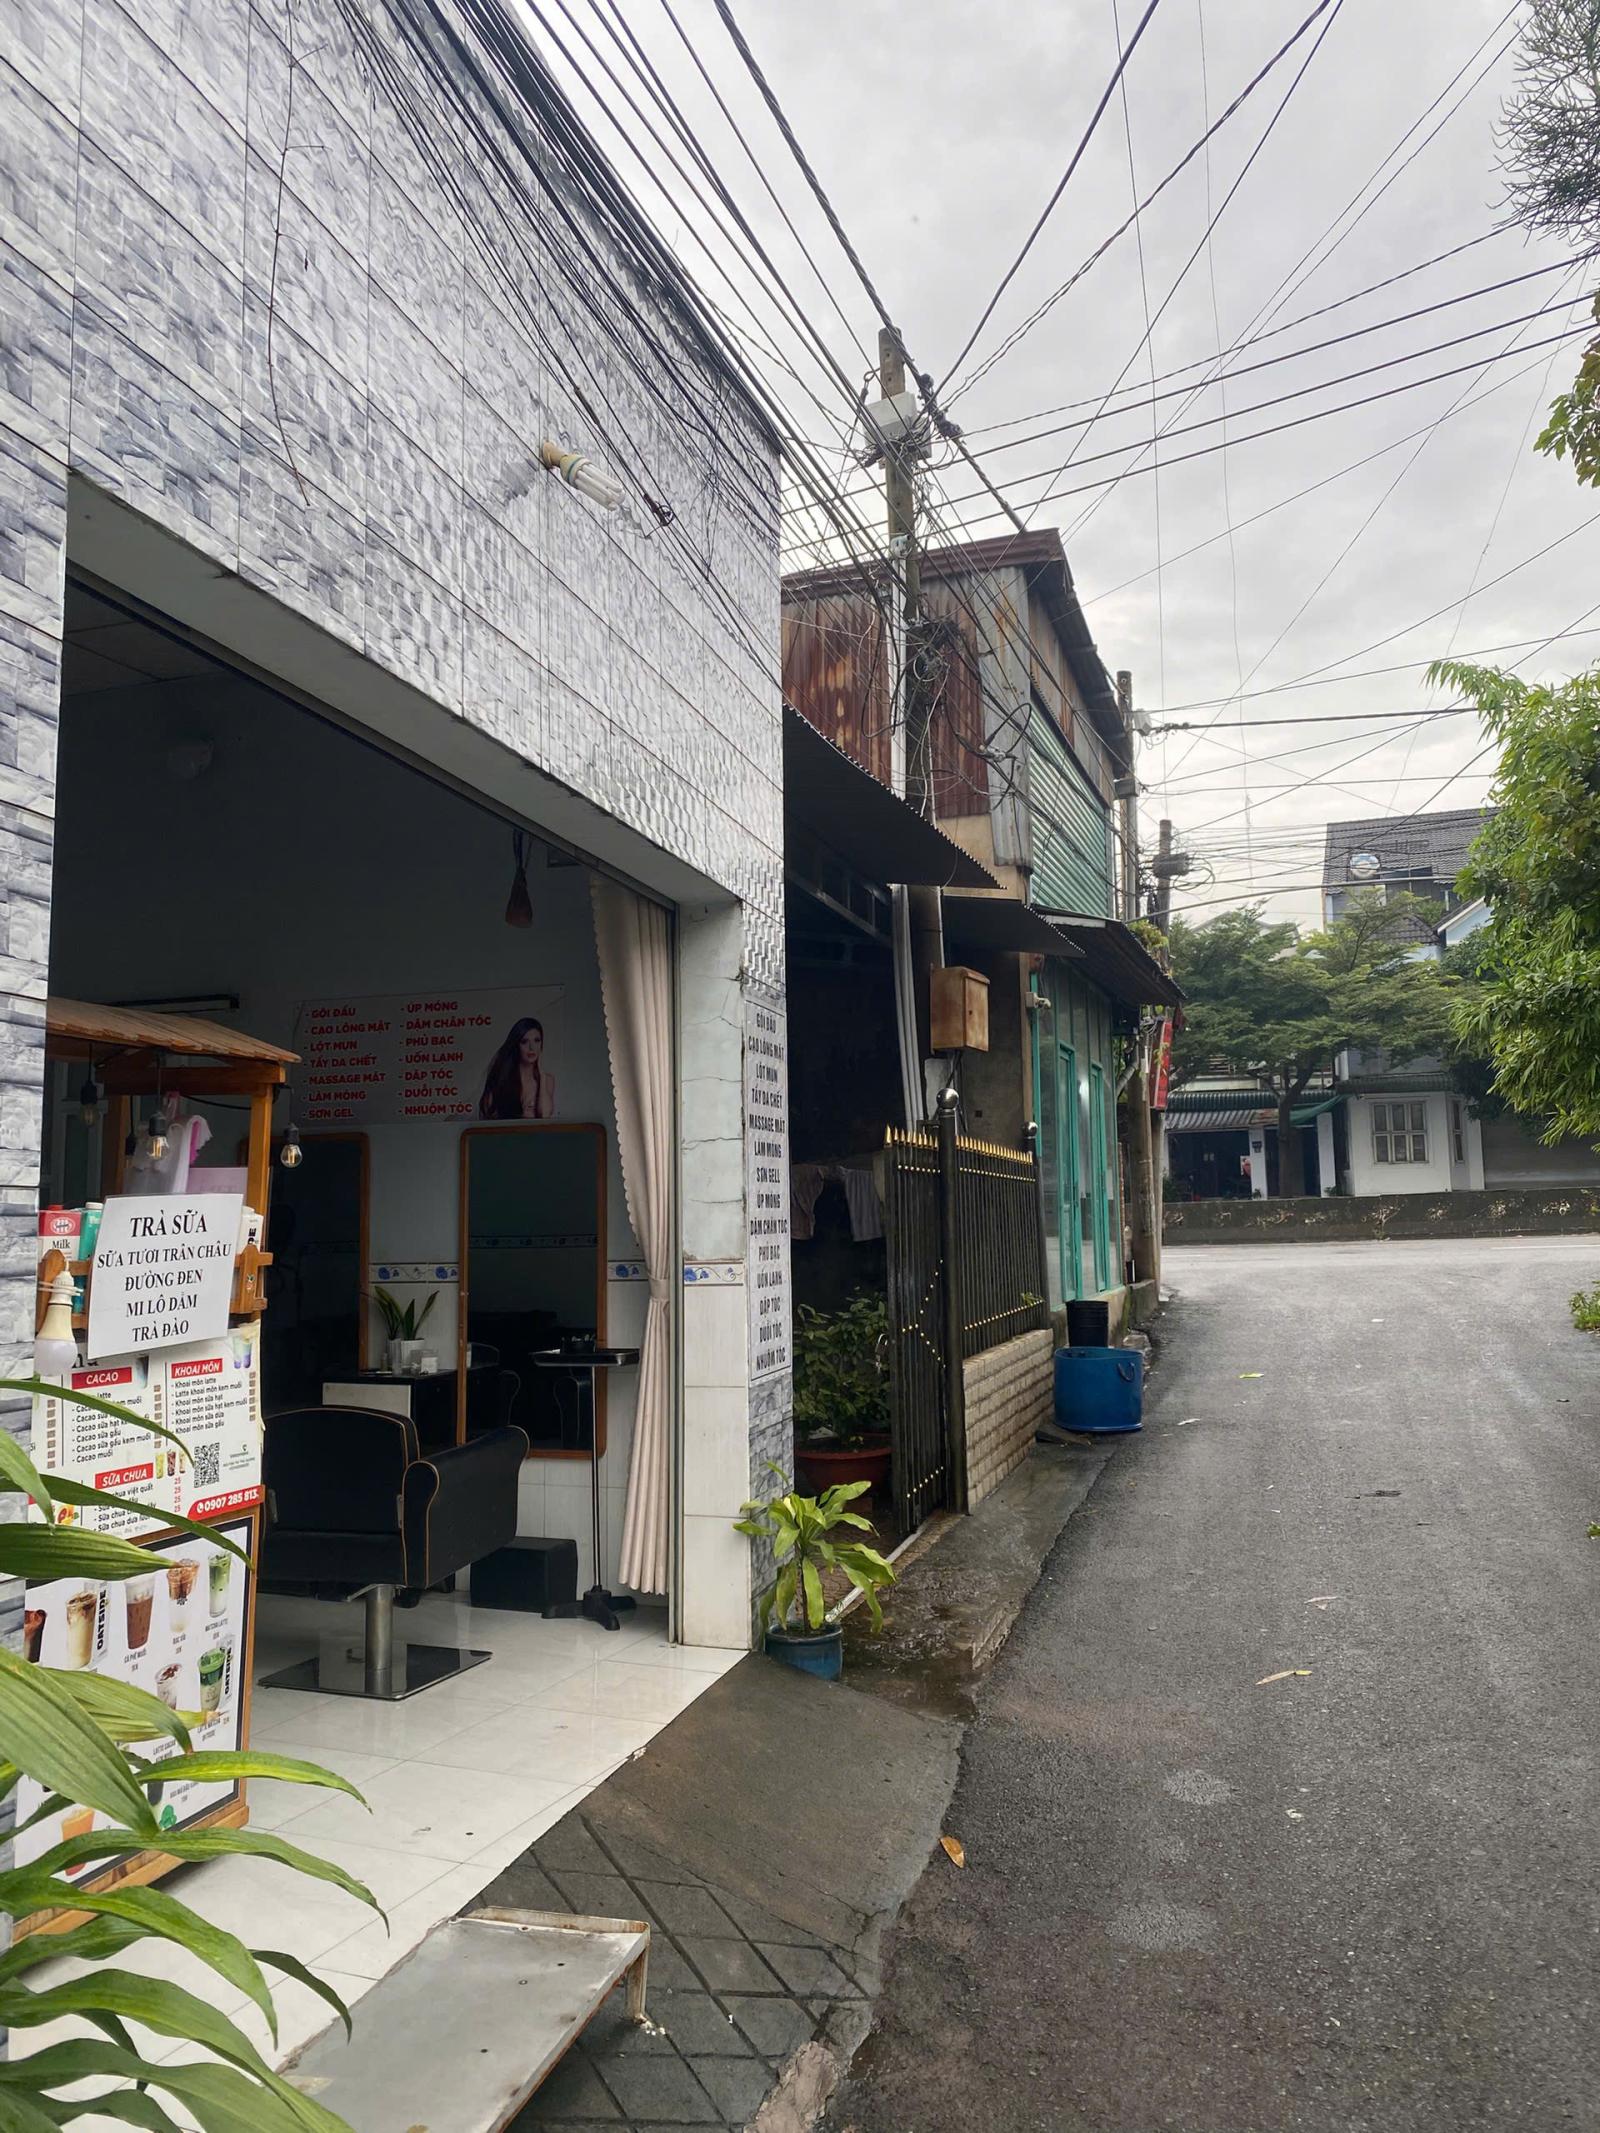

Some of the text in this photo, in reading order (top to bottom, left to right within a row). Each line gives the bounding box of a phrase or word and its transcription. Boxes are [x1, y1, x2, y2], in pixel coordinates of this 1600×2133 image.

[424, 1000, 458, 1012] MÓNG
[433, 1016, 465, 1028] CHÂN
[468, 1014, 492, 1026] TÓC
[336, 1022, 365, 1033] LÔNG
[431, 1036, 454, 1048] BẠC
[332, 1058, 346, 1067] DA
[349, 1052, 377, 1066] CHẾT
[432, 1051, 463, 1065] LẠNH
[309, 1074, 361, 1085] MASSAGE
[430, 1068, 453, 1080] TÓC
[309, 1089, 366, 1102] LÀM MÓNG
[435, 1085, 458, 1096] TÓC
[762, 1091, 770, 1106] DA
[449, 1101, 473, 1113] TÓC
[309, 1108, 354, 1119] SƠN GEL
[749, 1114, 774, 1132] MASSAGE
[768, 1168, 780, 1183] GELL
[130, 1209, 208, 1238] TRÀ SỮA
[778, 1217, 788, 1234] TÓC
[52, 1239, 71, 1249] Milk
[97, 1240, 232, 1269] SỮA TƯƠI TRÂN CHÂU
[125, 1269, 203, 1291] ĐƯỜNG ĐEN
[126, 1300, 144, 1318] MI
[147, 1294, 166, 1314] LÔ
[771, 1295, 781, 1312] TÓC
[132, 1317, 189, 1342] TRÀ ĐÀO
[772, 1320, 782, 1338] TÓC
[776, 1347, 785, 1364] TÓC
[174, 1362, 220, 1377] KHOAI MÔN
[86, 1372, 119, 1385] CACAO
[175, 1379, 190, 1389] Khoai
[175, 1390, 189, 1398] Latte
[175, 1398, 190, 1407] Khoai
[192, 1396, 204, 1404] môn
[175, 1407, 191, 1416] Khoai
[192, 1405, 204, 1413] môn
[76, 1414, 96, 1423] Cacao
[175, 1416, 191, 1425] Khoai
[192, 1414, 204, 1422] môn
[76, 1424, 96, 1433] Cacao
[175, 1425, 191, 1434] Khoai
[192, 1423, 204, 1431] môn
[76, 1434, 96, 1443] Cacao
[76, 1444, 96, 1453] Cacao
[76, 1454, 96, 1463] Cacao
[101, 1468, 147, 1487] SỮA CHUA
[204, 1497, 226, 1512] 0907
[227, 1492, 243, 1505] 285
[111, 1510, 126, 1519] chua
[111, 1520, 126, 1529] chua
[97, 1589, 106, 1650] OATSIDE
